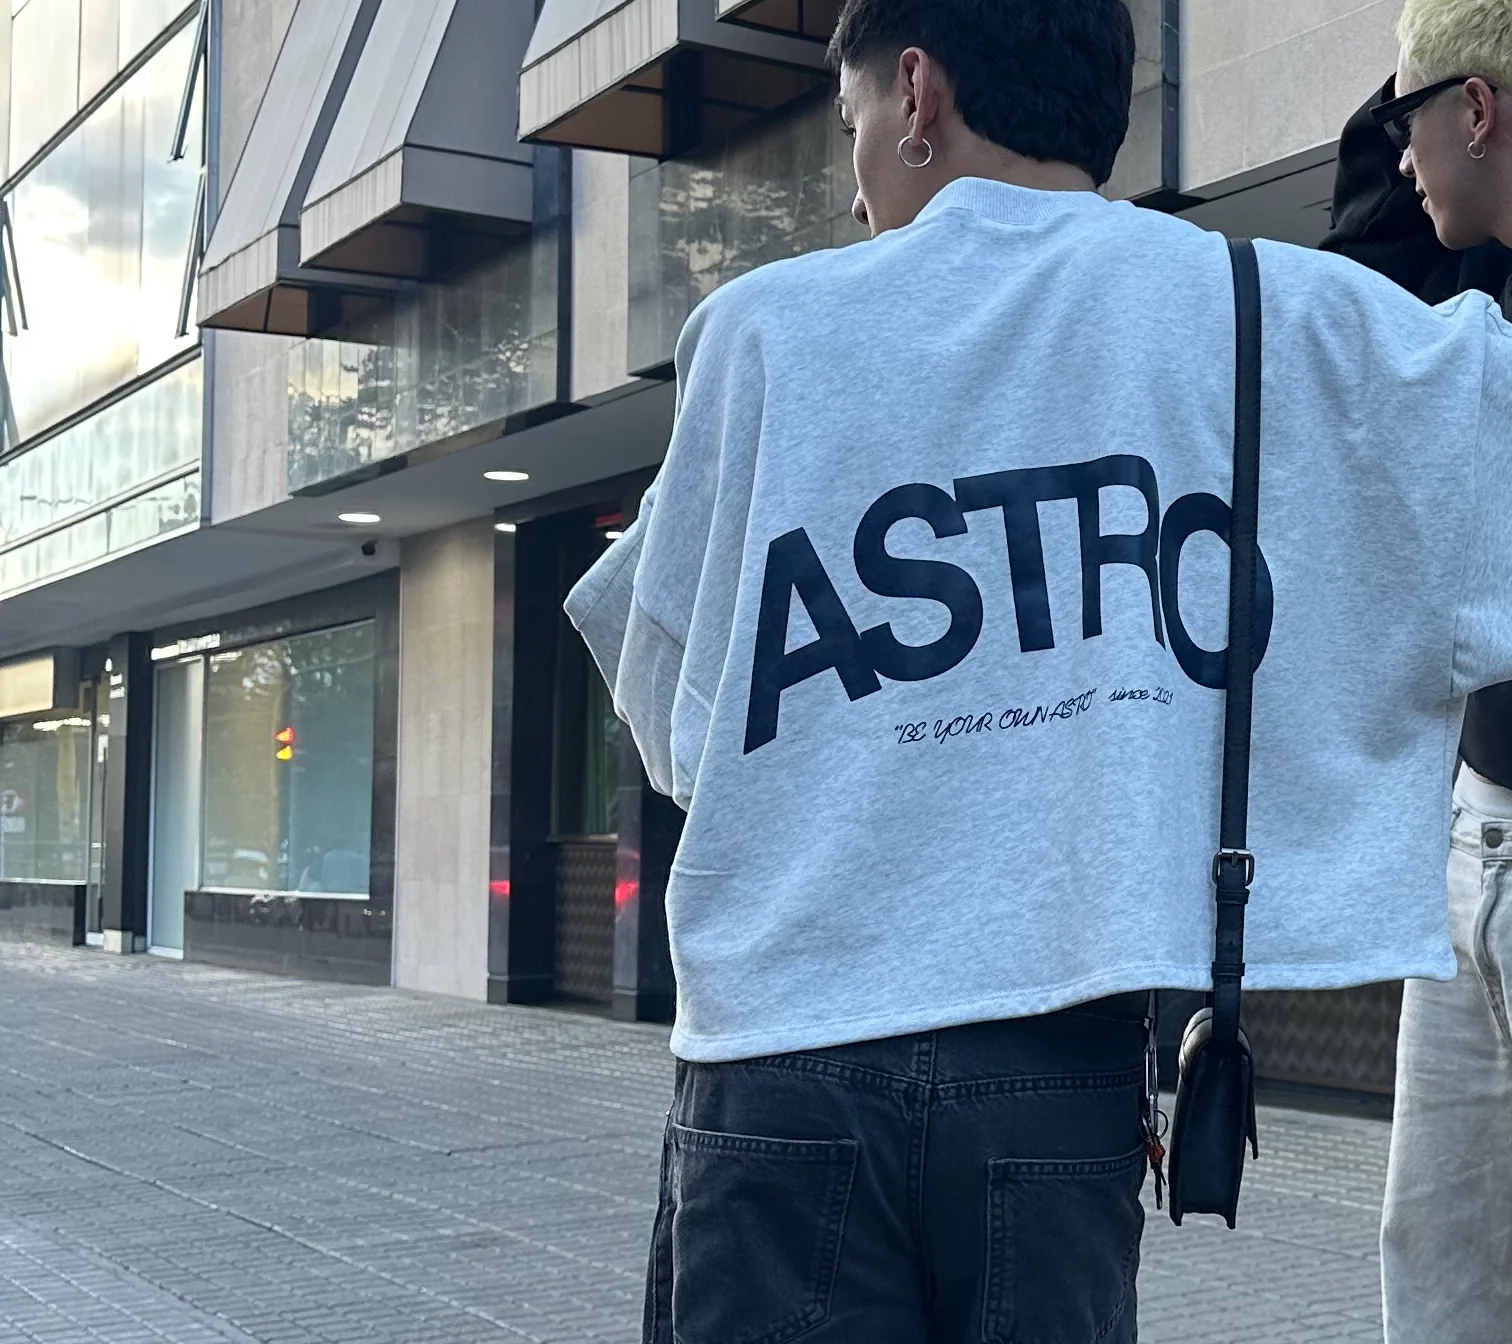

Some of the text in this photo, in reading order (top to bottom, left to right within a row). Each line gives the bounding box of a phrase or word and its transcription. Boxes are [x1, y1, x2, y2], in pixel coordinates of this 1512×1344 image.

[743, 453, 1275, 755] ASTRO
[933, 712, 993, 745] YOUR
[999, 706, 1049, 730] OWN
